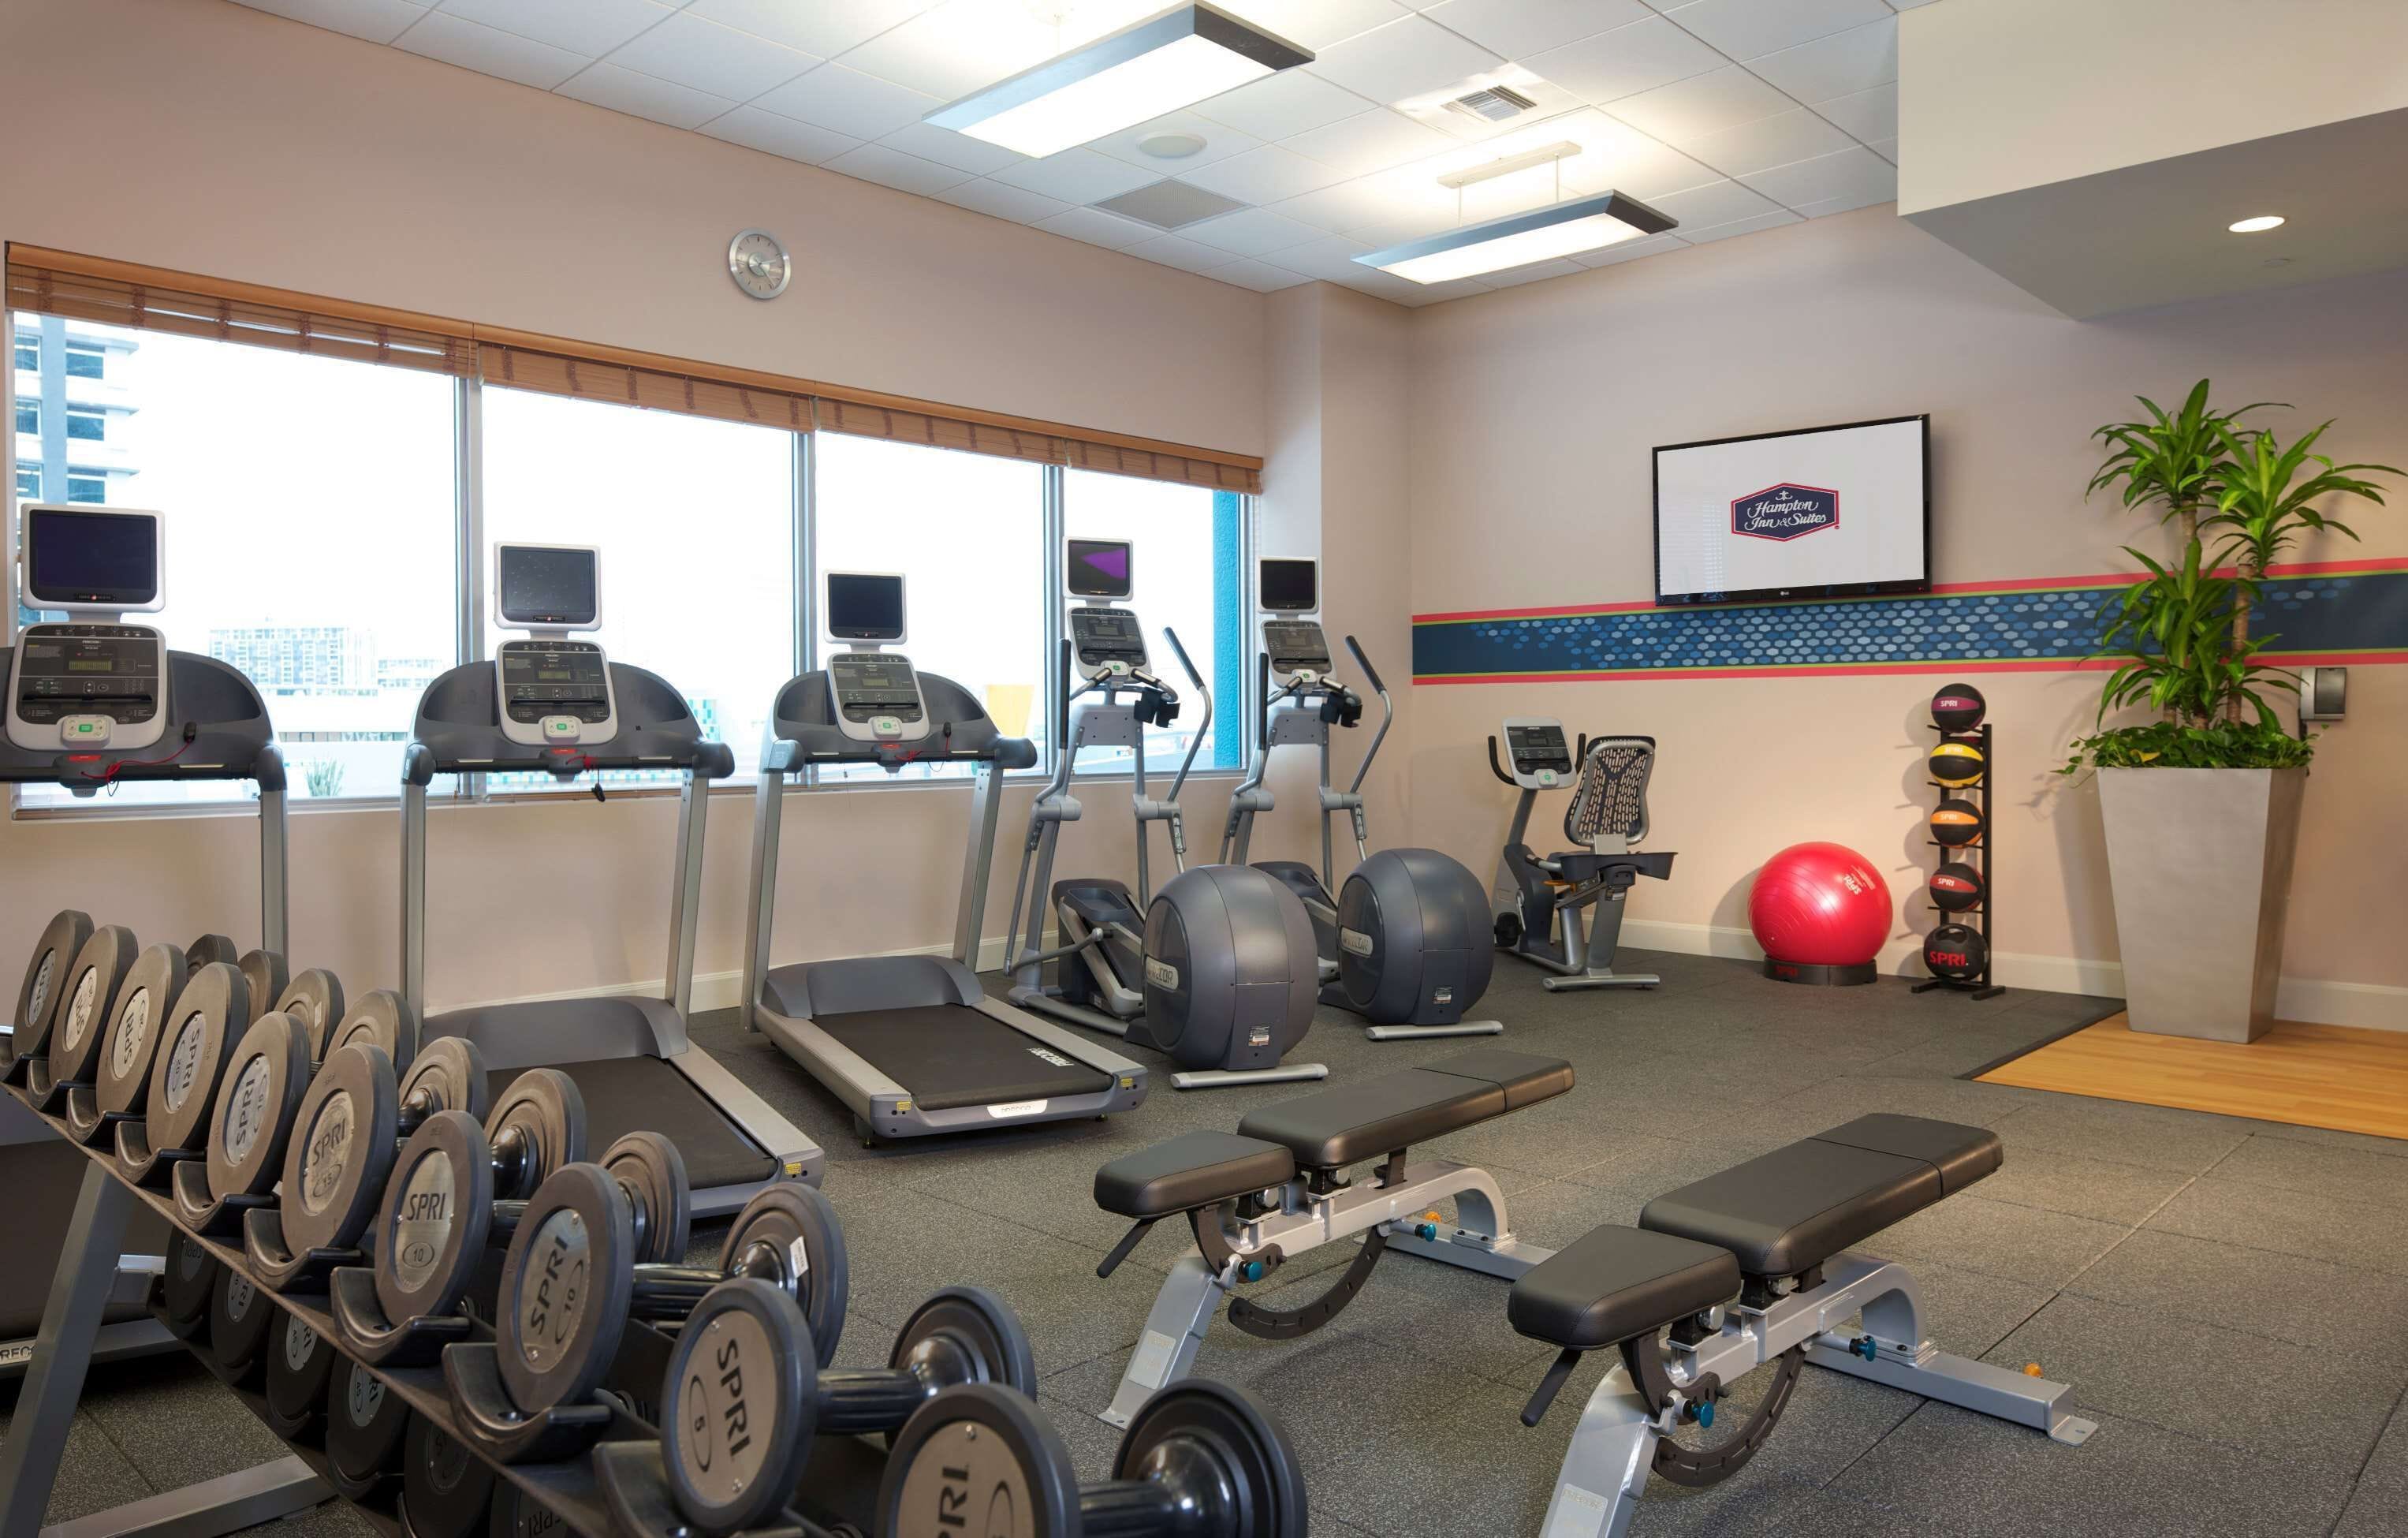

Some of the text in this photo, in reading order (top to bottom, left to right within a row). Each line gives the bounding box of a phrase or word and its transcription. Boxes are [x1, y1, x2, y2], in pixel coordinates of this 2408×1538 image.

[1744, 513, 1826, 531] Inn & Suites
[1747, 500, 1819, 517] Hampton
[1843, 874, 1862, 895] SPRI
[1937, 877, 1955, 887] SPRI
[124, 1011, 135, 1065] SPRI
[182, 1028, 200, 1089] SPRI
[237, 1078, 255, 1146] SPRI
[313, 1118, 346, 1166] SPRI
[407, 1193, 446, 1221] SPRI
[413, 1248, 423, 1262] 10
[531, 1235, 568, 1335] SPRI
[565, 1288, 576, 1312] 10
[717, 1338, 751, 1457] SPRI
